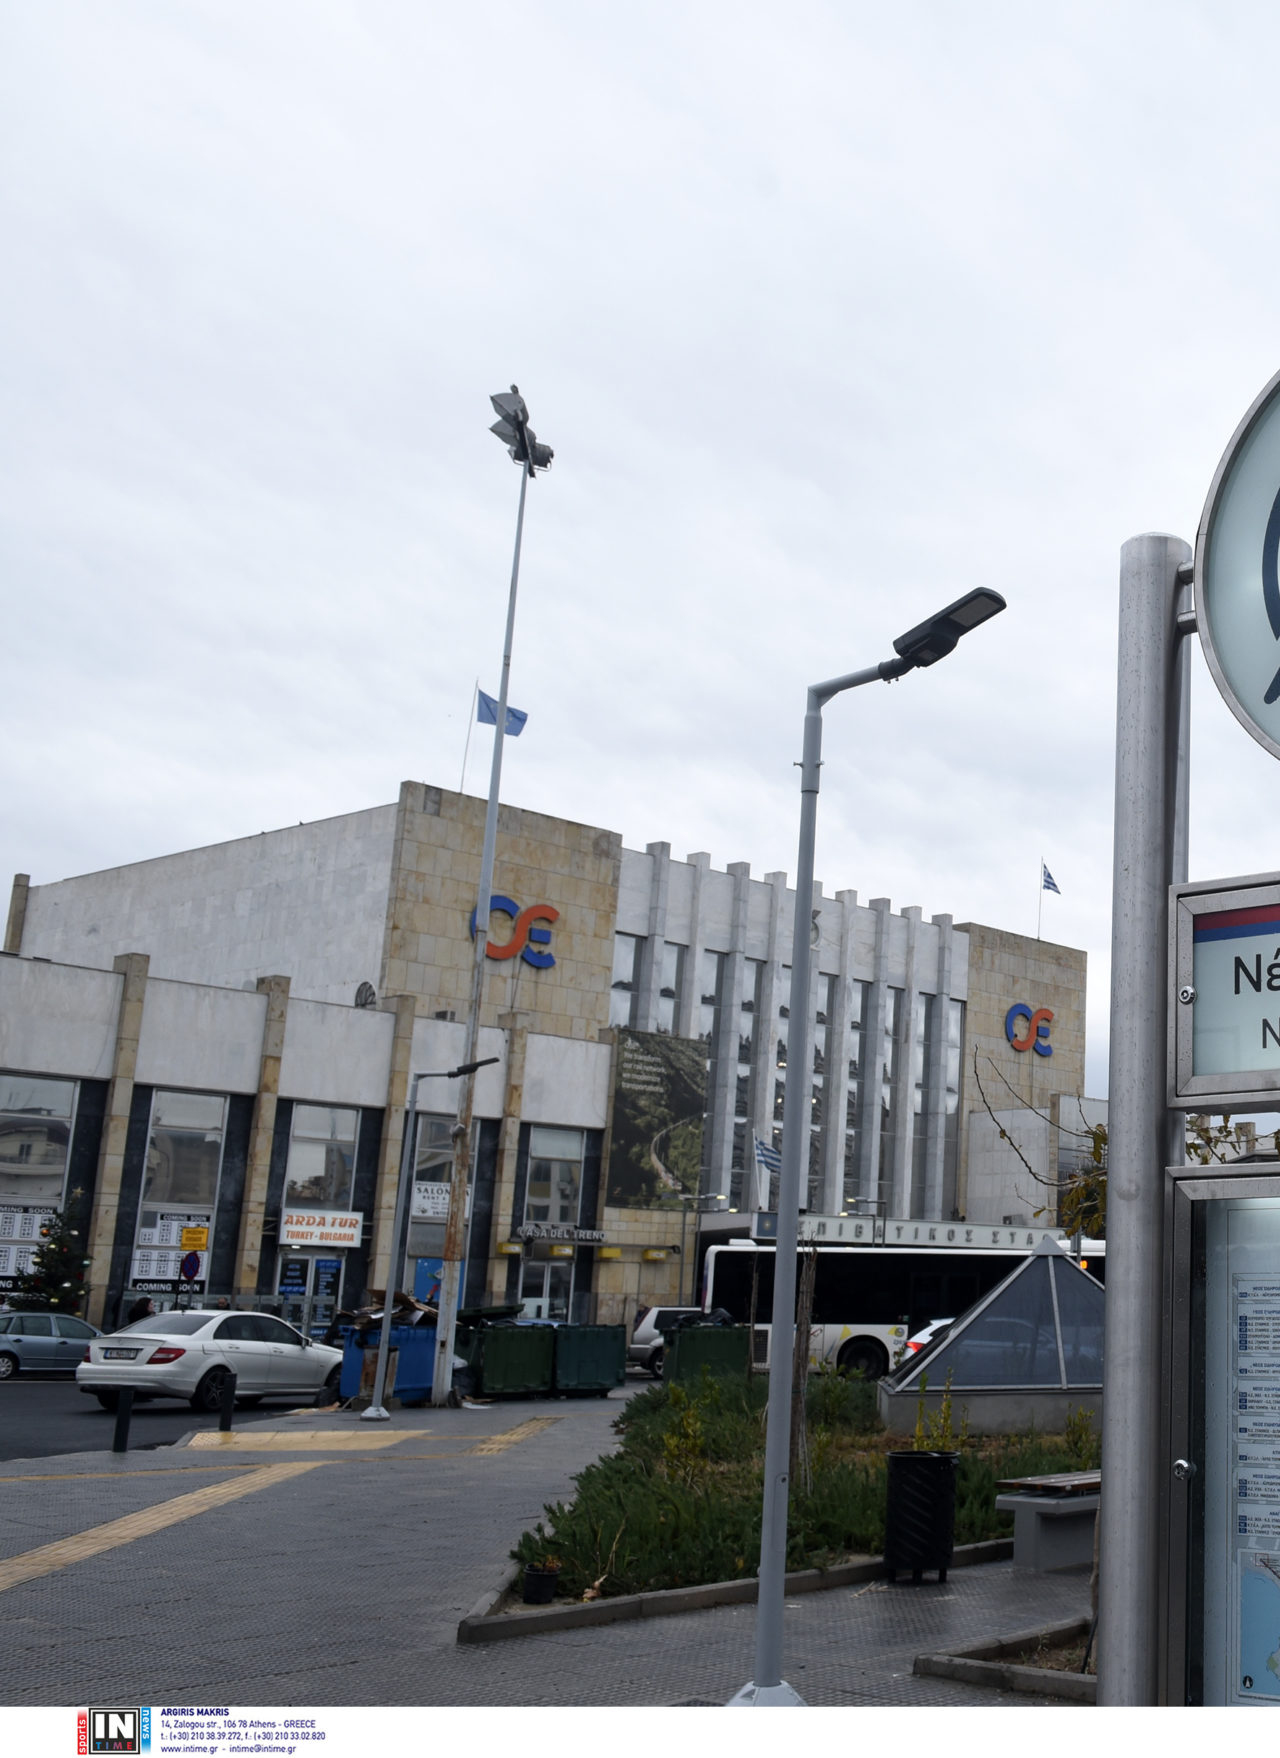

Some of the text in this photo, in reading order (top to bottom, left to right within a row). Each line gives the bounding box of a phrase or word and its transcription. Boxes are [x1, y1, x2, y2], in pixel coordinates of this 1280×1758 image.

[284, 1214, 359, 1228] ARDA TUR
[286, 1230, 314, 1240] TURKEY
[319, 1231, 355, 1242] BULGARIA
[519, 1227, 607, 1240] CASA DEL TRENO
[136, 1282, 172, 1291] COMING
